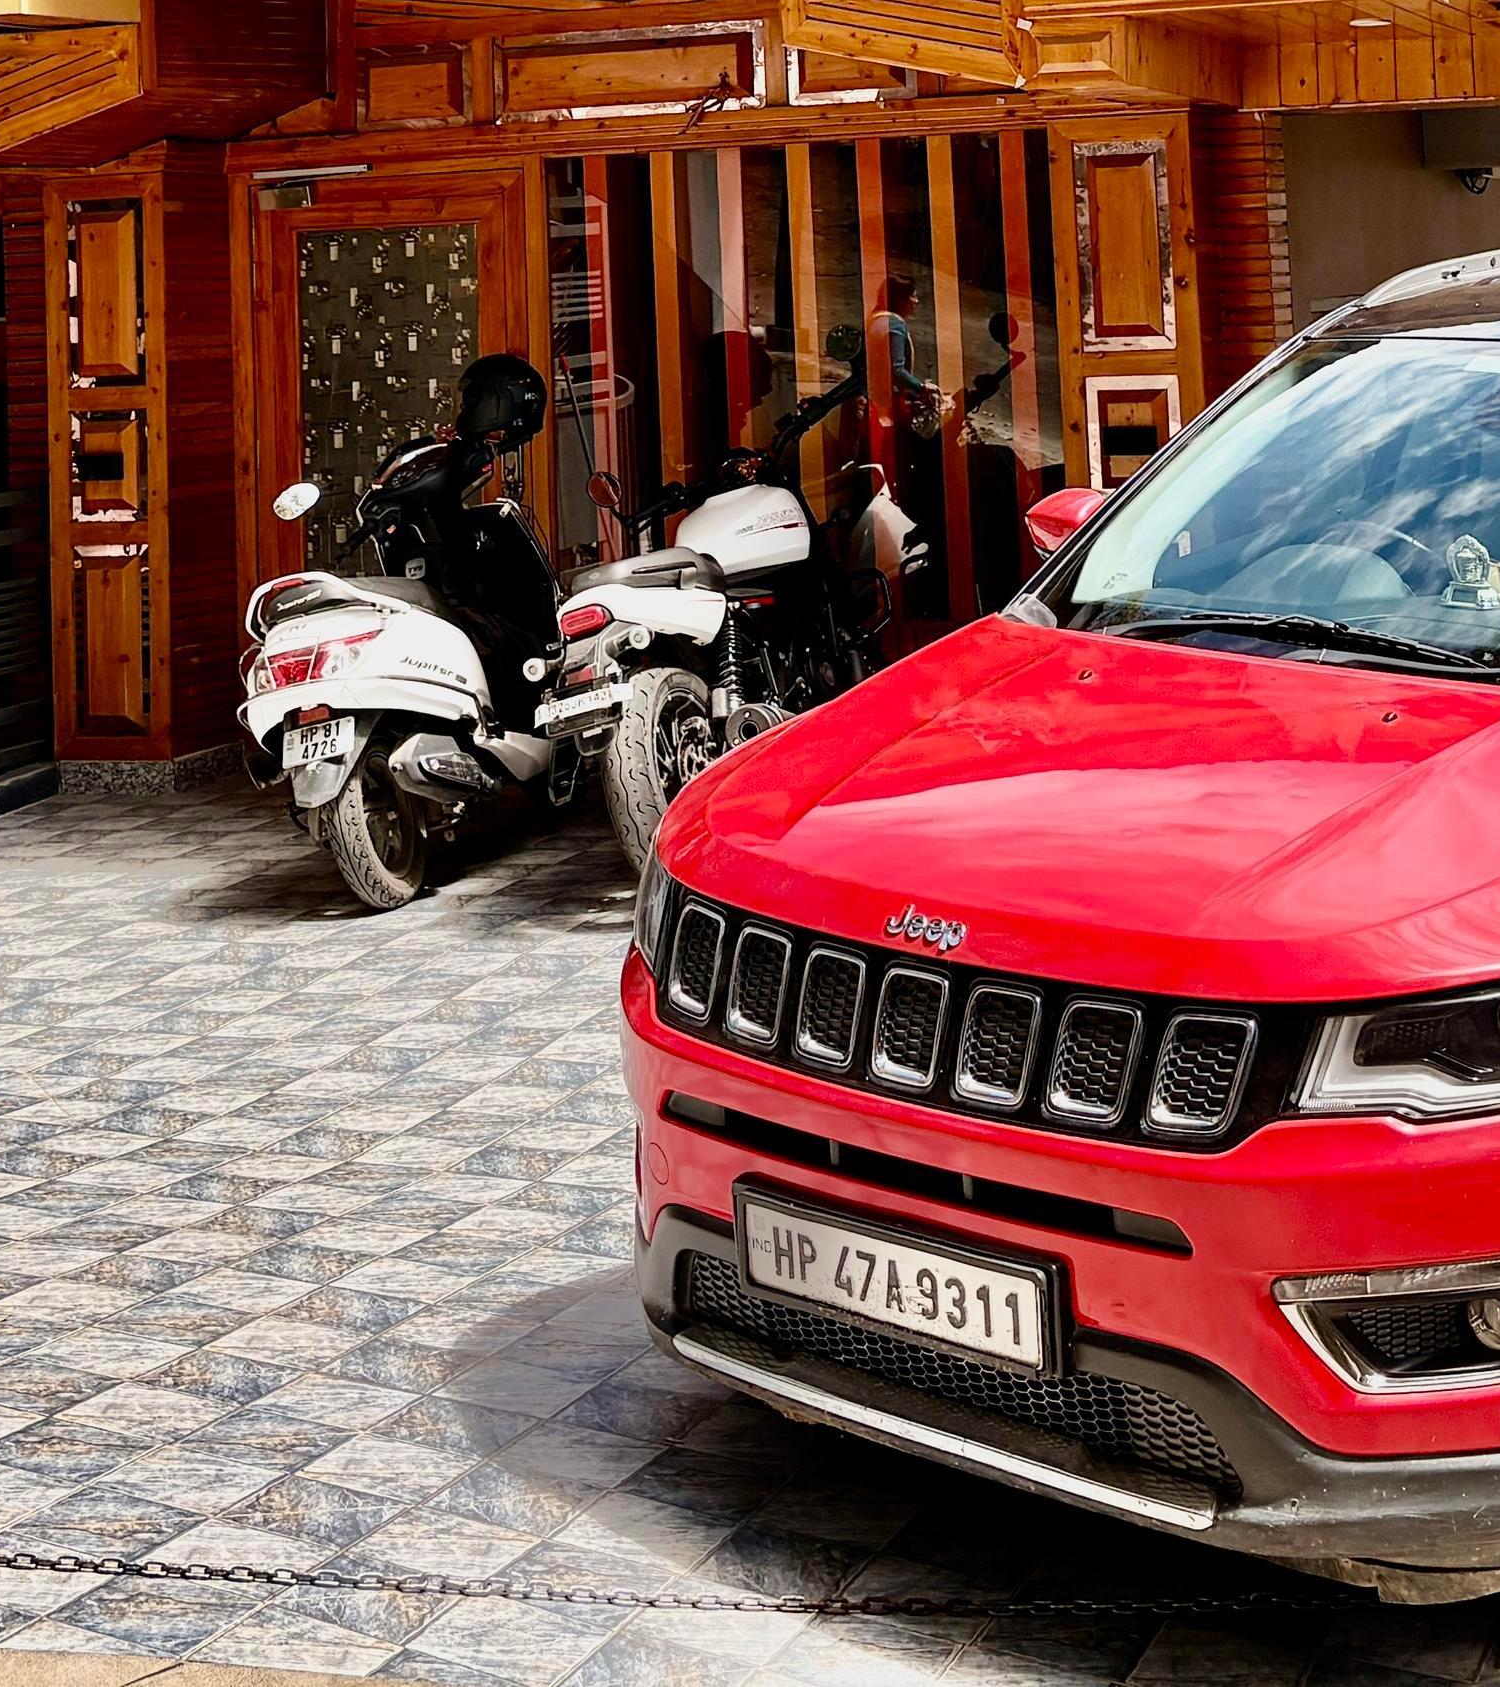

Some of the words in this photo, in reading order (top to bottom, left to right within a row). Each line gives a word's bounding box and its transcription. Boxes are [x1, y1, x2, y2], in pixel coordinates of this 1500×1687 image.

[301, 727, 318, 745] HP
[323, 721, 340, 738] 81
[302, 738, 337, 759] 4726
[886, 904, 967, 951] Jeep
[772, 1226, 817, 1283] HP
